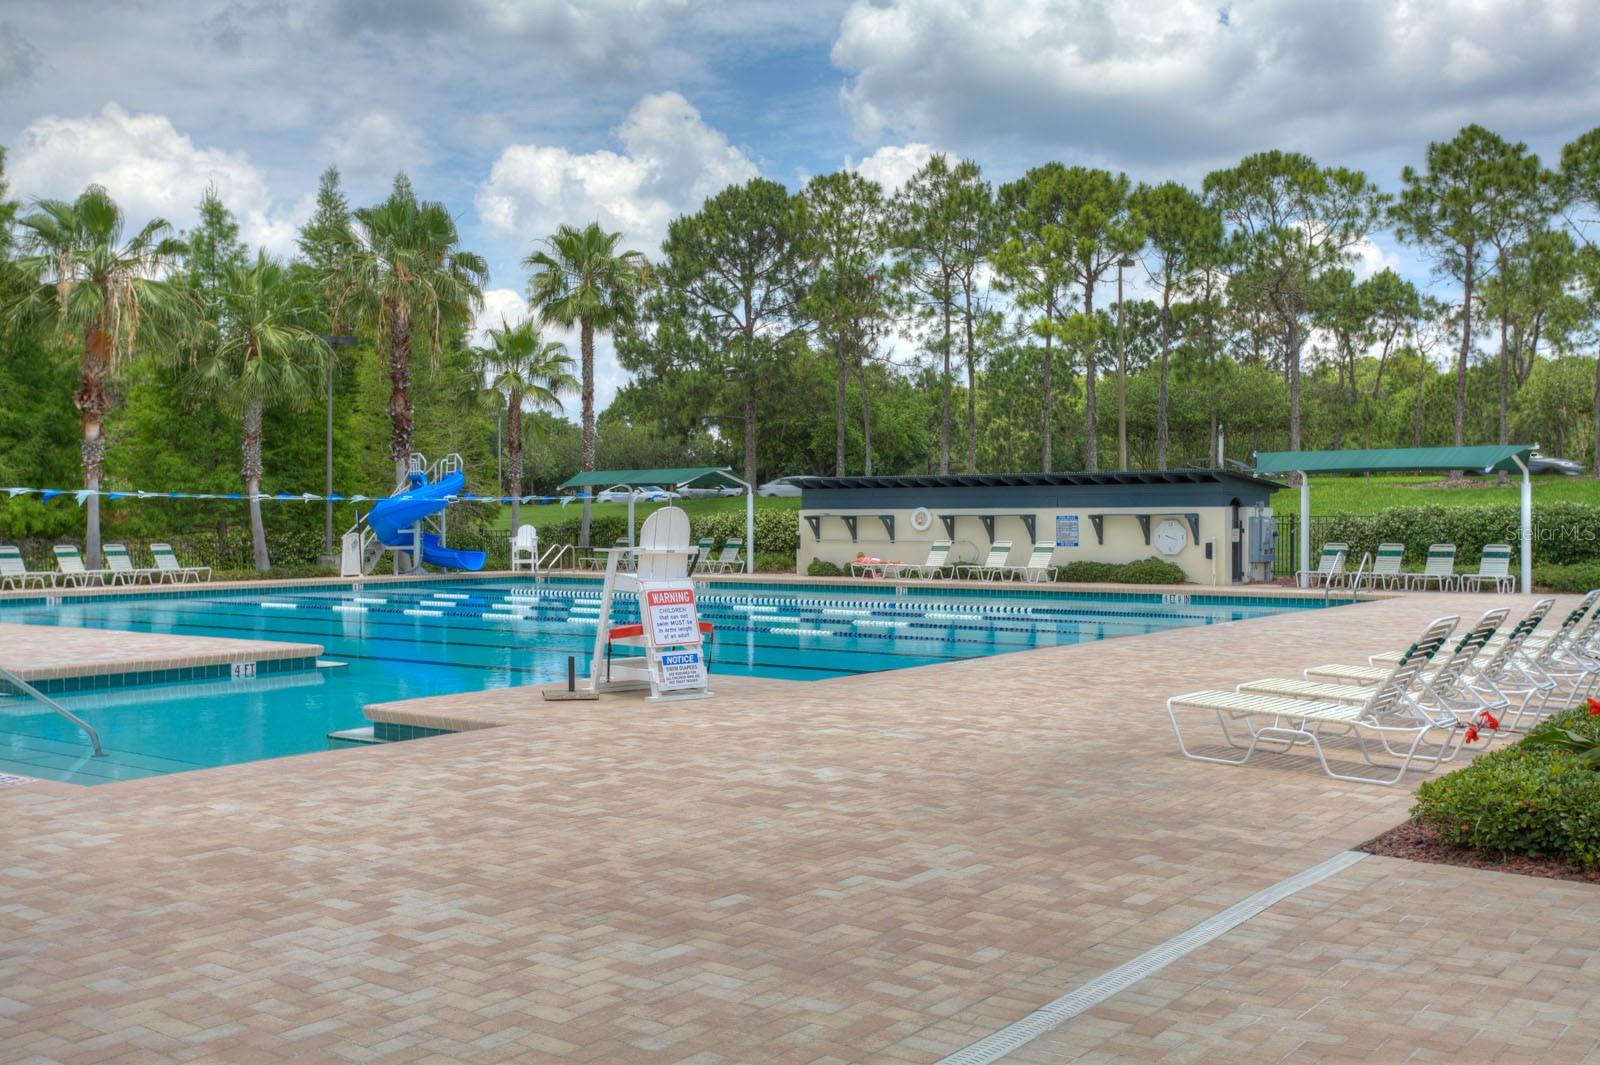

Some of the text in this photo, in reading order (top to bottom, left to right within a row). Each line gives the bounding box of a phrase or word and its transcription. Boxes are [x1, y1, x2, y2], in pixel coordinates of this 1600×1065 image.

[652, 592, 689, 604] WARNING
[667, 655, 694, 664] NOTICE
[234, 663, 256, 678] 4 FT
